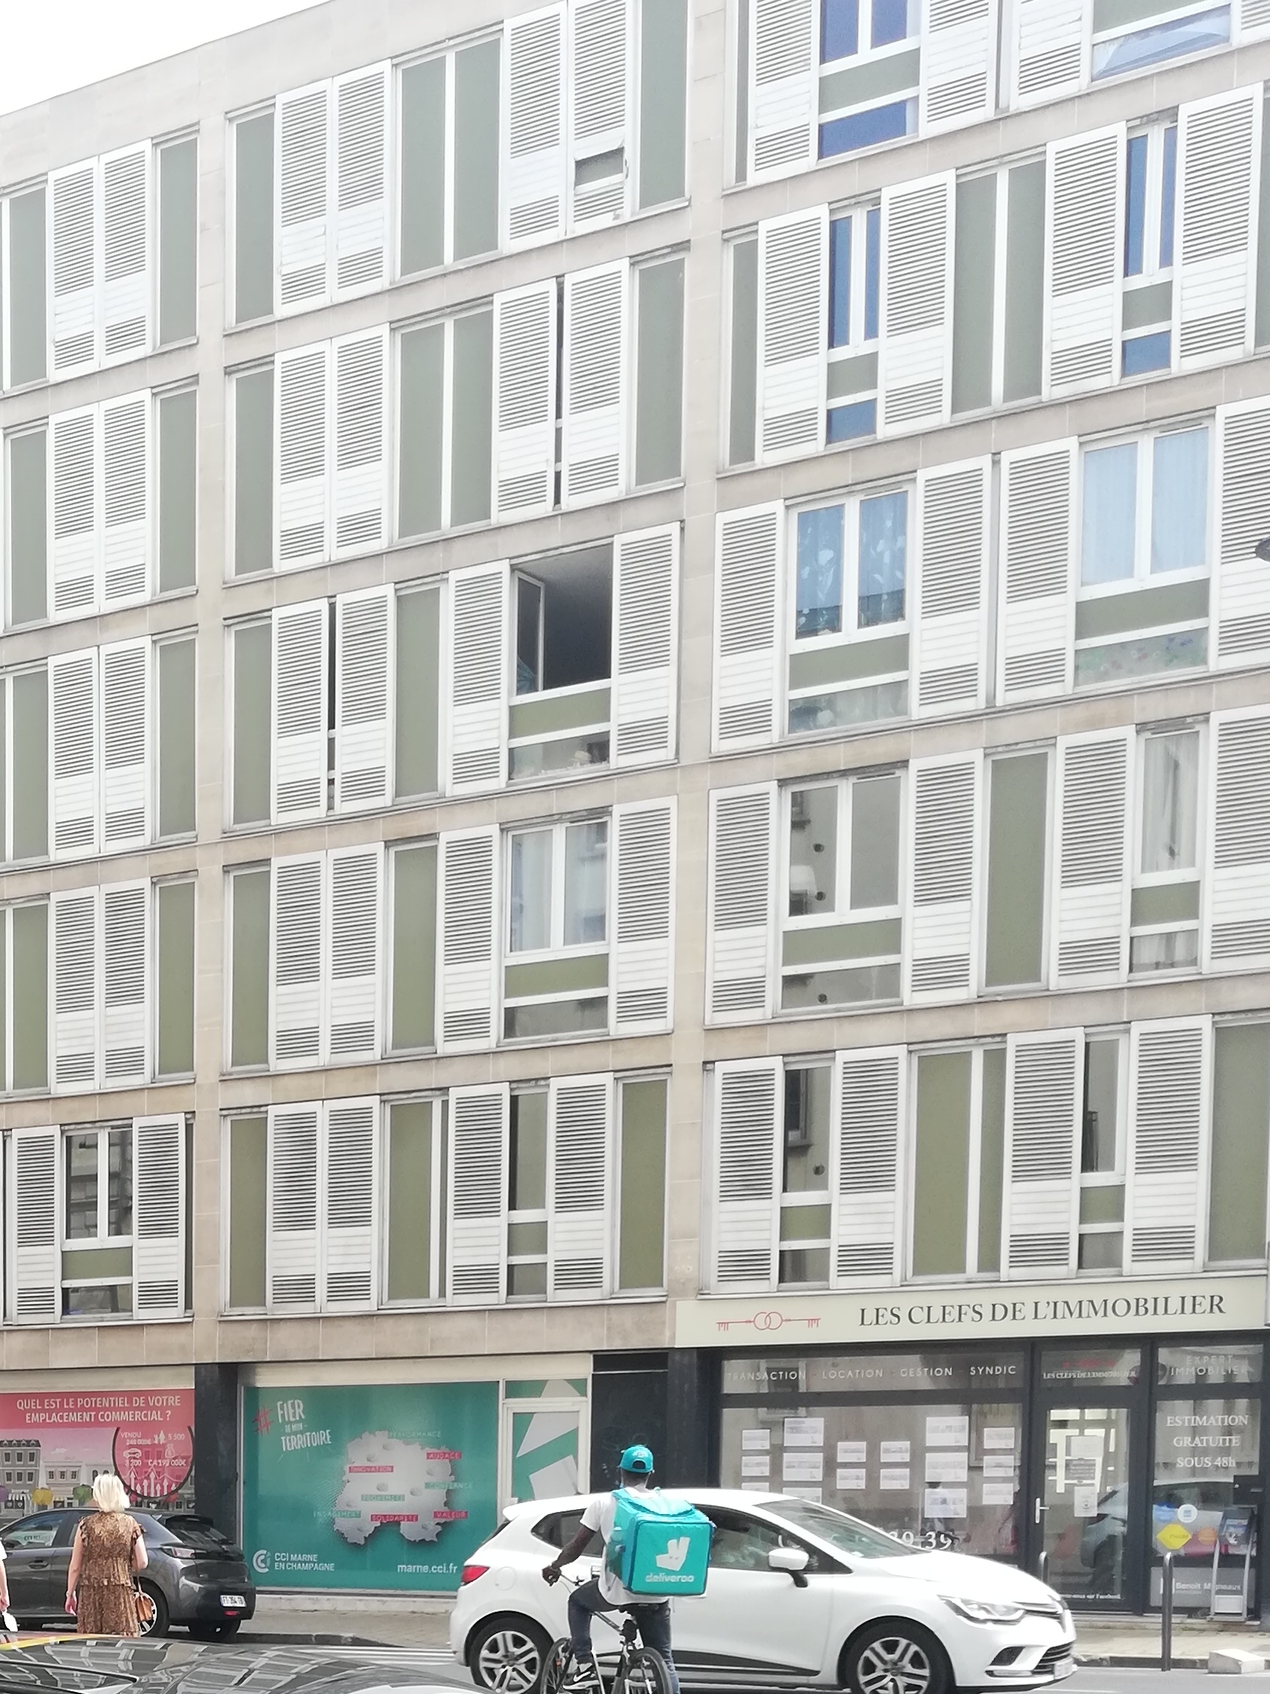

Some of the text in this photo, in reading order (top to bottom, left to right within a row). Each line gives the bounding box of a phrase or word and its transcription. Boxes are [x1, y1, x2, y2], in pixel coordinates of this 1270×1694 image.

[859, 1294, 1227, 1326] LES CLEFS DE L'IMMOBILIER
[726, 1365, 1017, 1381] TRANSACTION LOCATION GESTION SYNDIC
[1170, 1365, 1247, 1376] IMMOBILIER
[17, 1395, 181, 1410] QUEL EST LE POTENTIEL DE VOTRE
[25, 1411, 95, 1424] EMPLACEMENT
[98, 1410, 164, 1422] COMMERCIAL
[277, 1399, 305, 1423] FIER
[1166, 1414, 1249, 1427] ESTIMATION
[281, 1429, 332, 1451] TERRITOIRE
[1173, 1435, 1241, 1447] GRATUITE
[1176, 1456, 1236, 1468] SOUS 48h
[274, 1553, 318, 1562] CCI MARNE
[274, 1562, 335, 1571] EN CHAMPAGNE
[397, 1563, 458, 1574] marne.cci.fr
[645, 1573, 695, 1582] deliveroo
